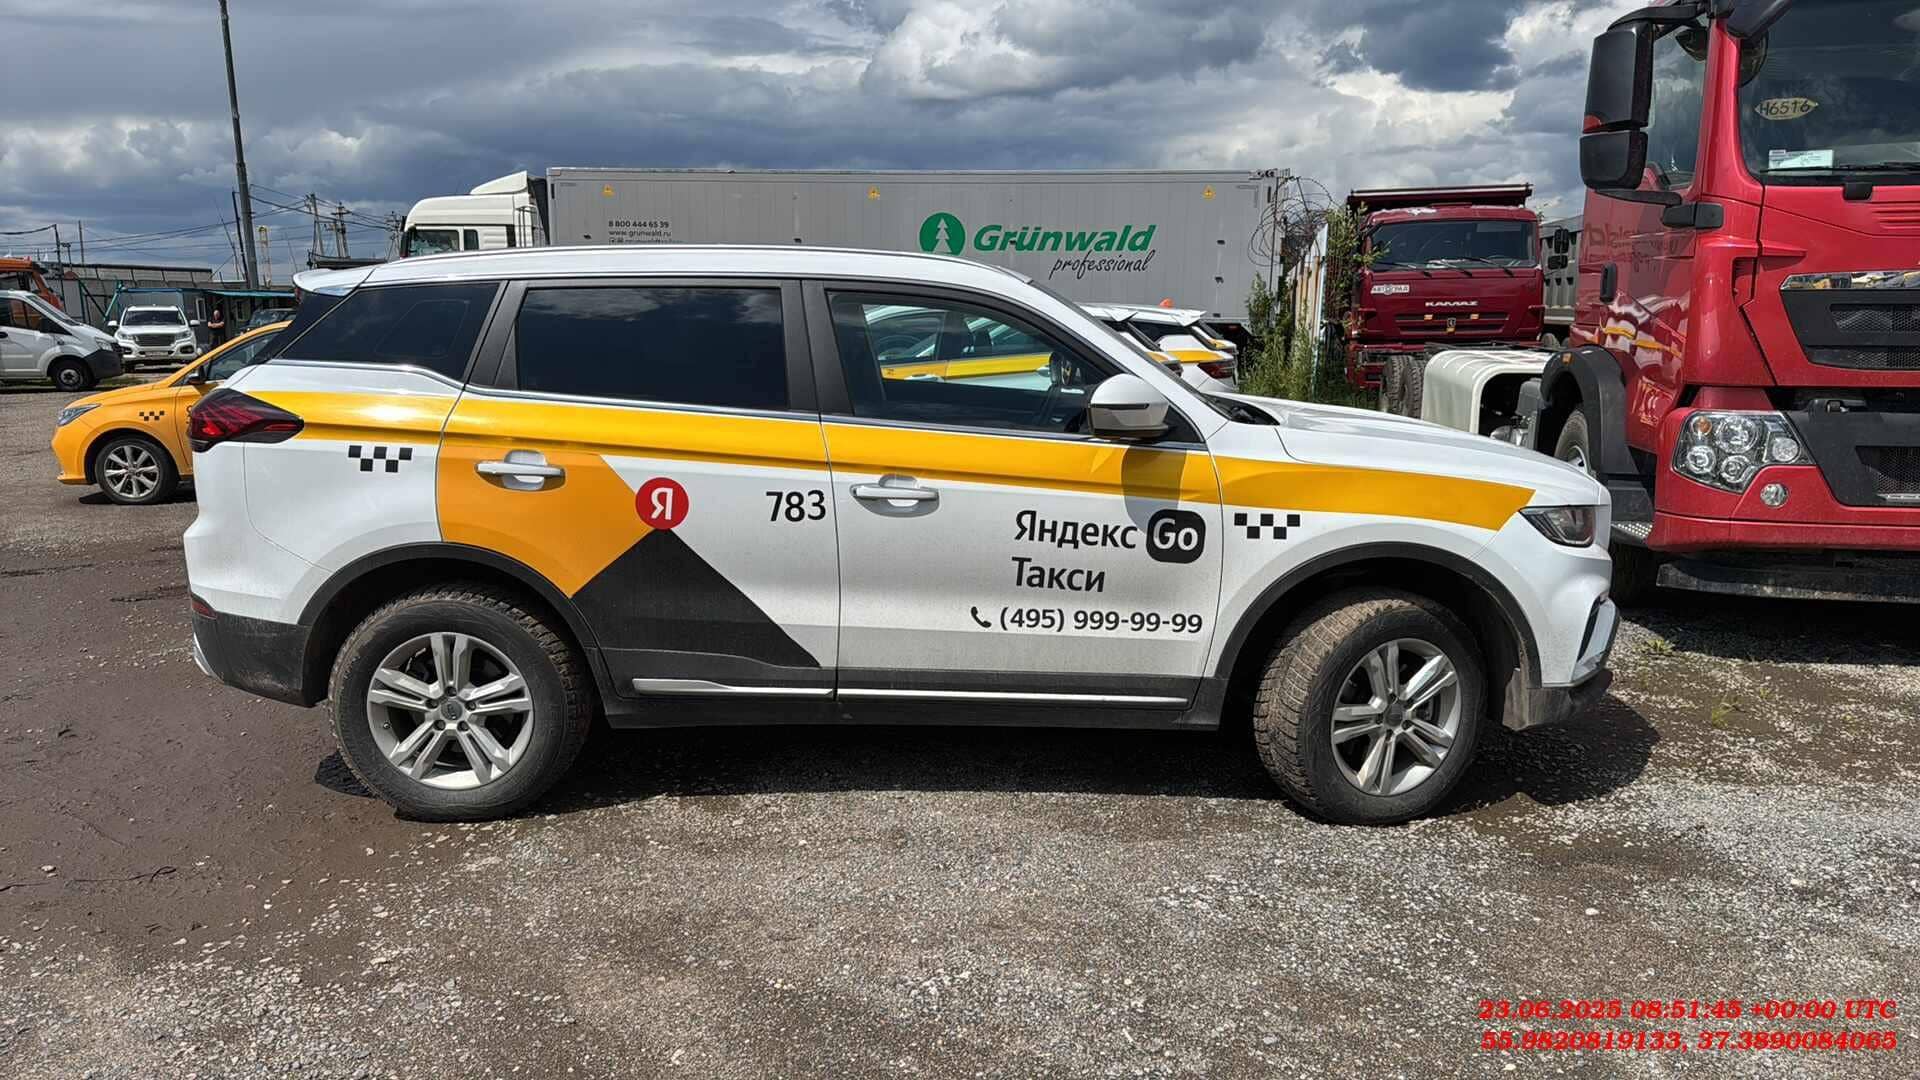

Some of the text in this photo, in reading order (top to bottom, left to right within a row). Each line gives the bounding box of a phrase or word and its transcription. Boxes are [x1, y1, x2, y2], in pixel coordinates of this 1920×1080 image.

[632, 220, 647, 228] 444
[973, 224, 1156, 251] Grünwald
[1049, 249, 1156, 280] professional
[650, 486, 674, 521] Я
[765, 489, 827, 522] 783
[1014, 509, 1199, 551] Яндекс Go
[1011, 556, 1106, 593] Такси
[1000, 606, 1203, 634] (495) 999-99-99
